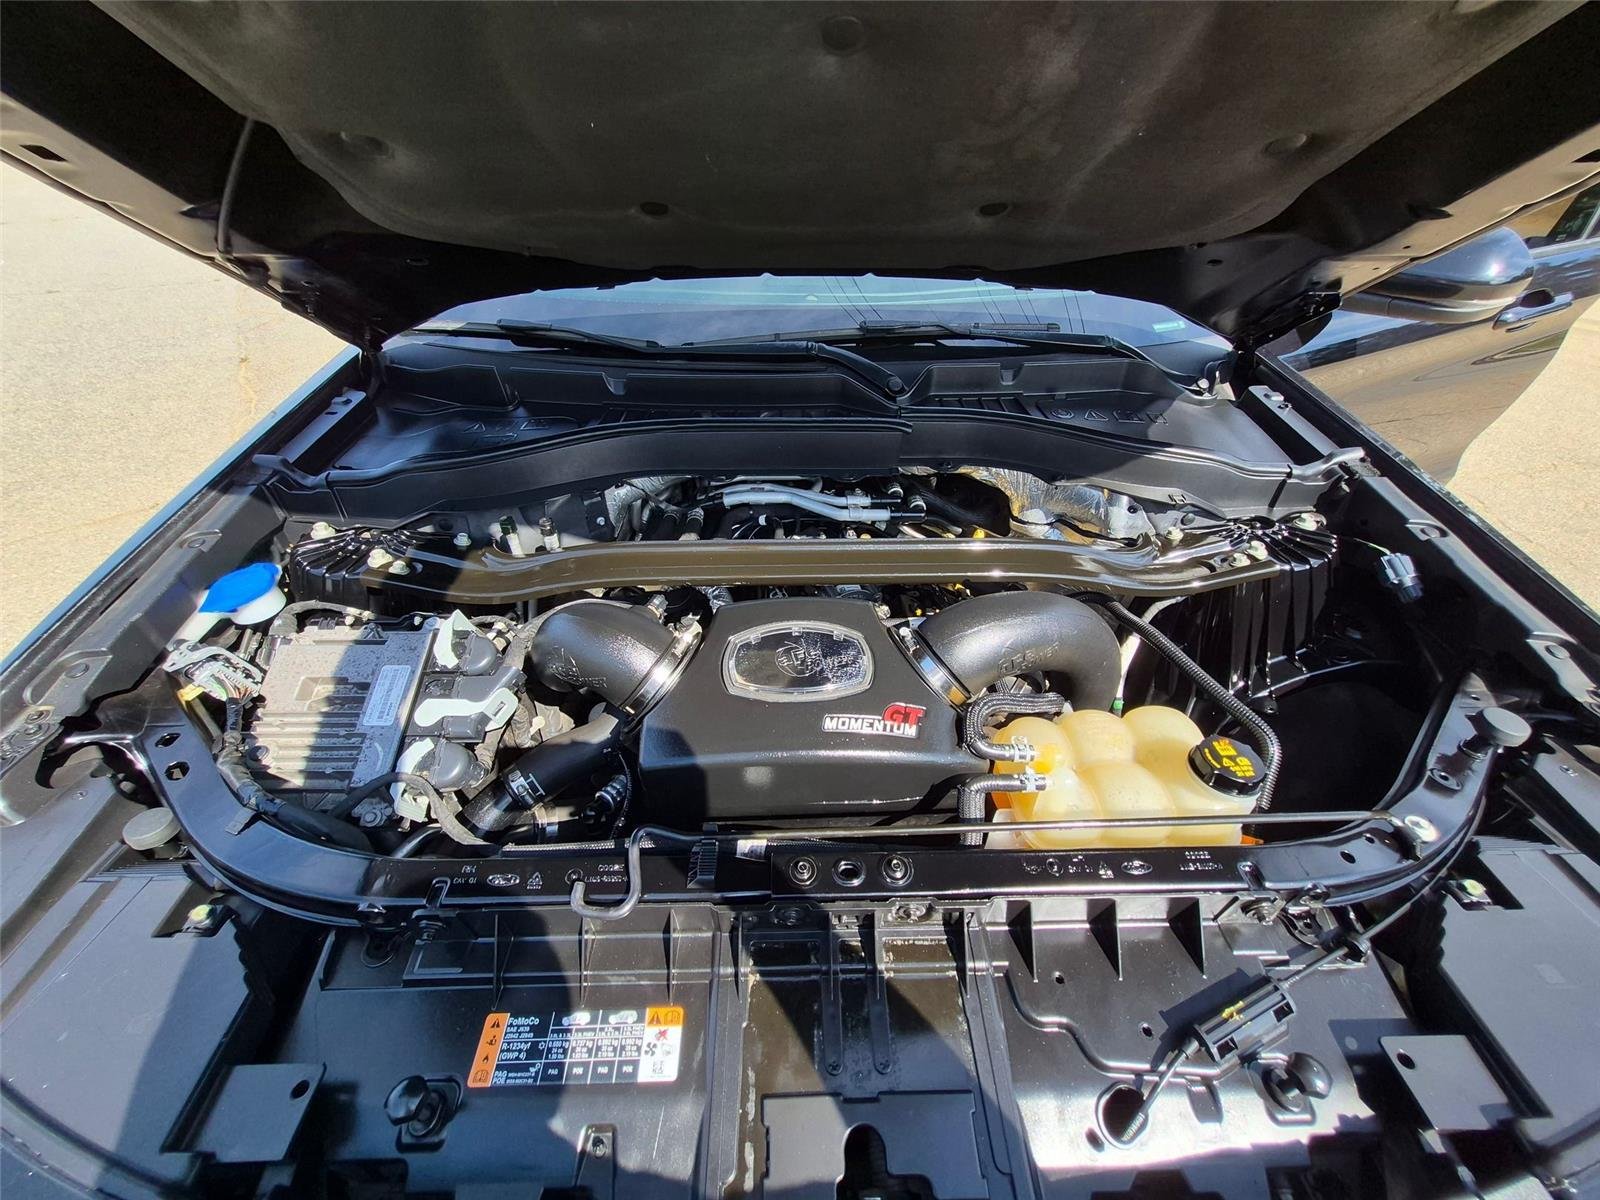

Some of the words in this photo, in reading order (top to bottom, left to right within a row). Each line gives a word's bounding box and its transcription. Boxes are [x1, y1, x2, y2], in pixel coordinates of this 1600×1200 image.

[882, 702, 926, 726] GT
[824, 717, 917, 737] MOMENTUM
[508, 1016, 540, 1026] FoMoCo
[501, 1042, 532, 1052] R-1234yf
[499, 1051, 519, 1061] (GWP
[519, 1051, 527, 1061] 4)
[494, 1070, 508, 1078] PAG
[492, 1077, 506, 1085] POE
